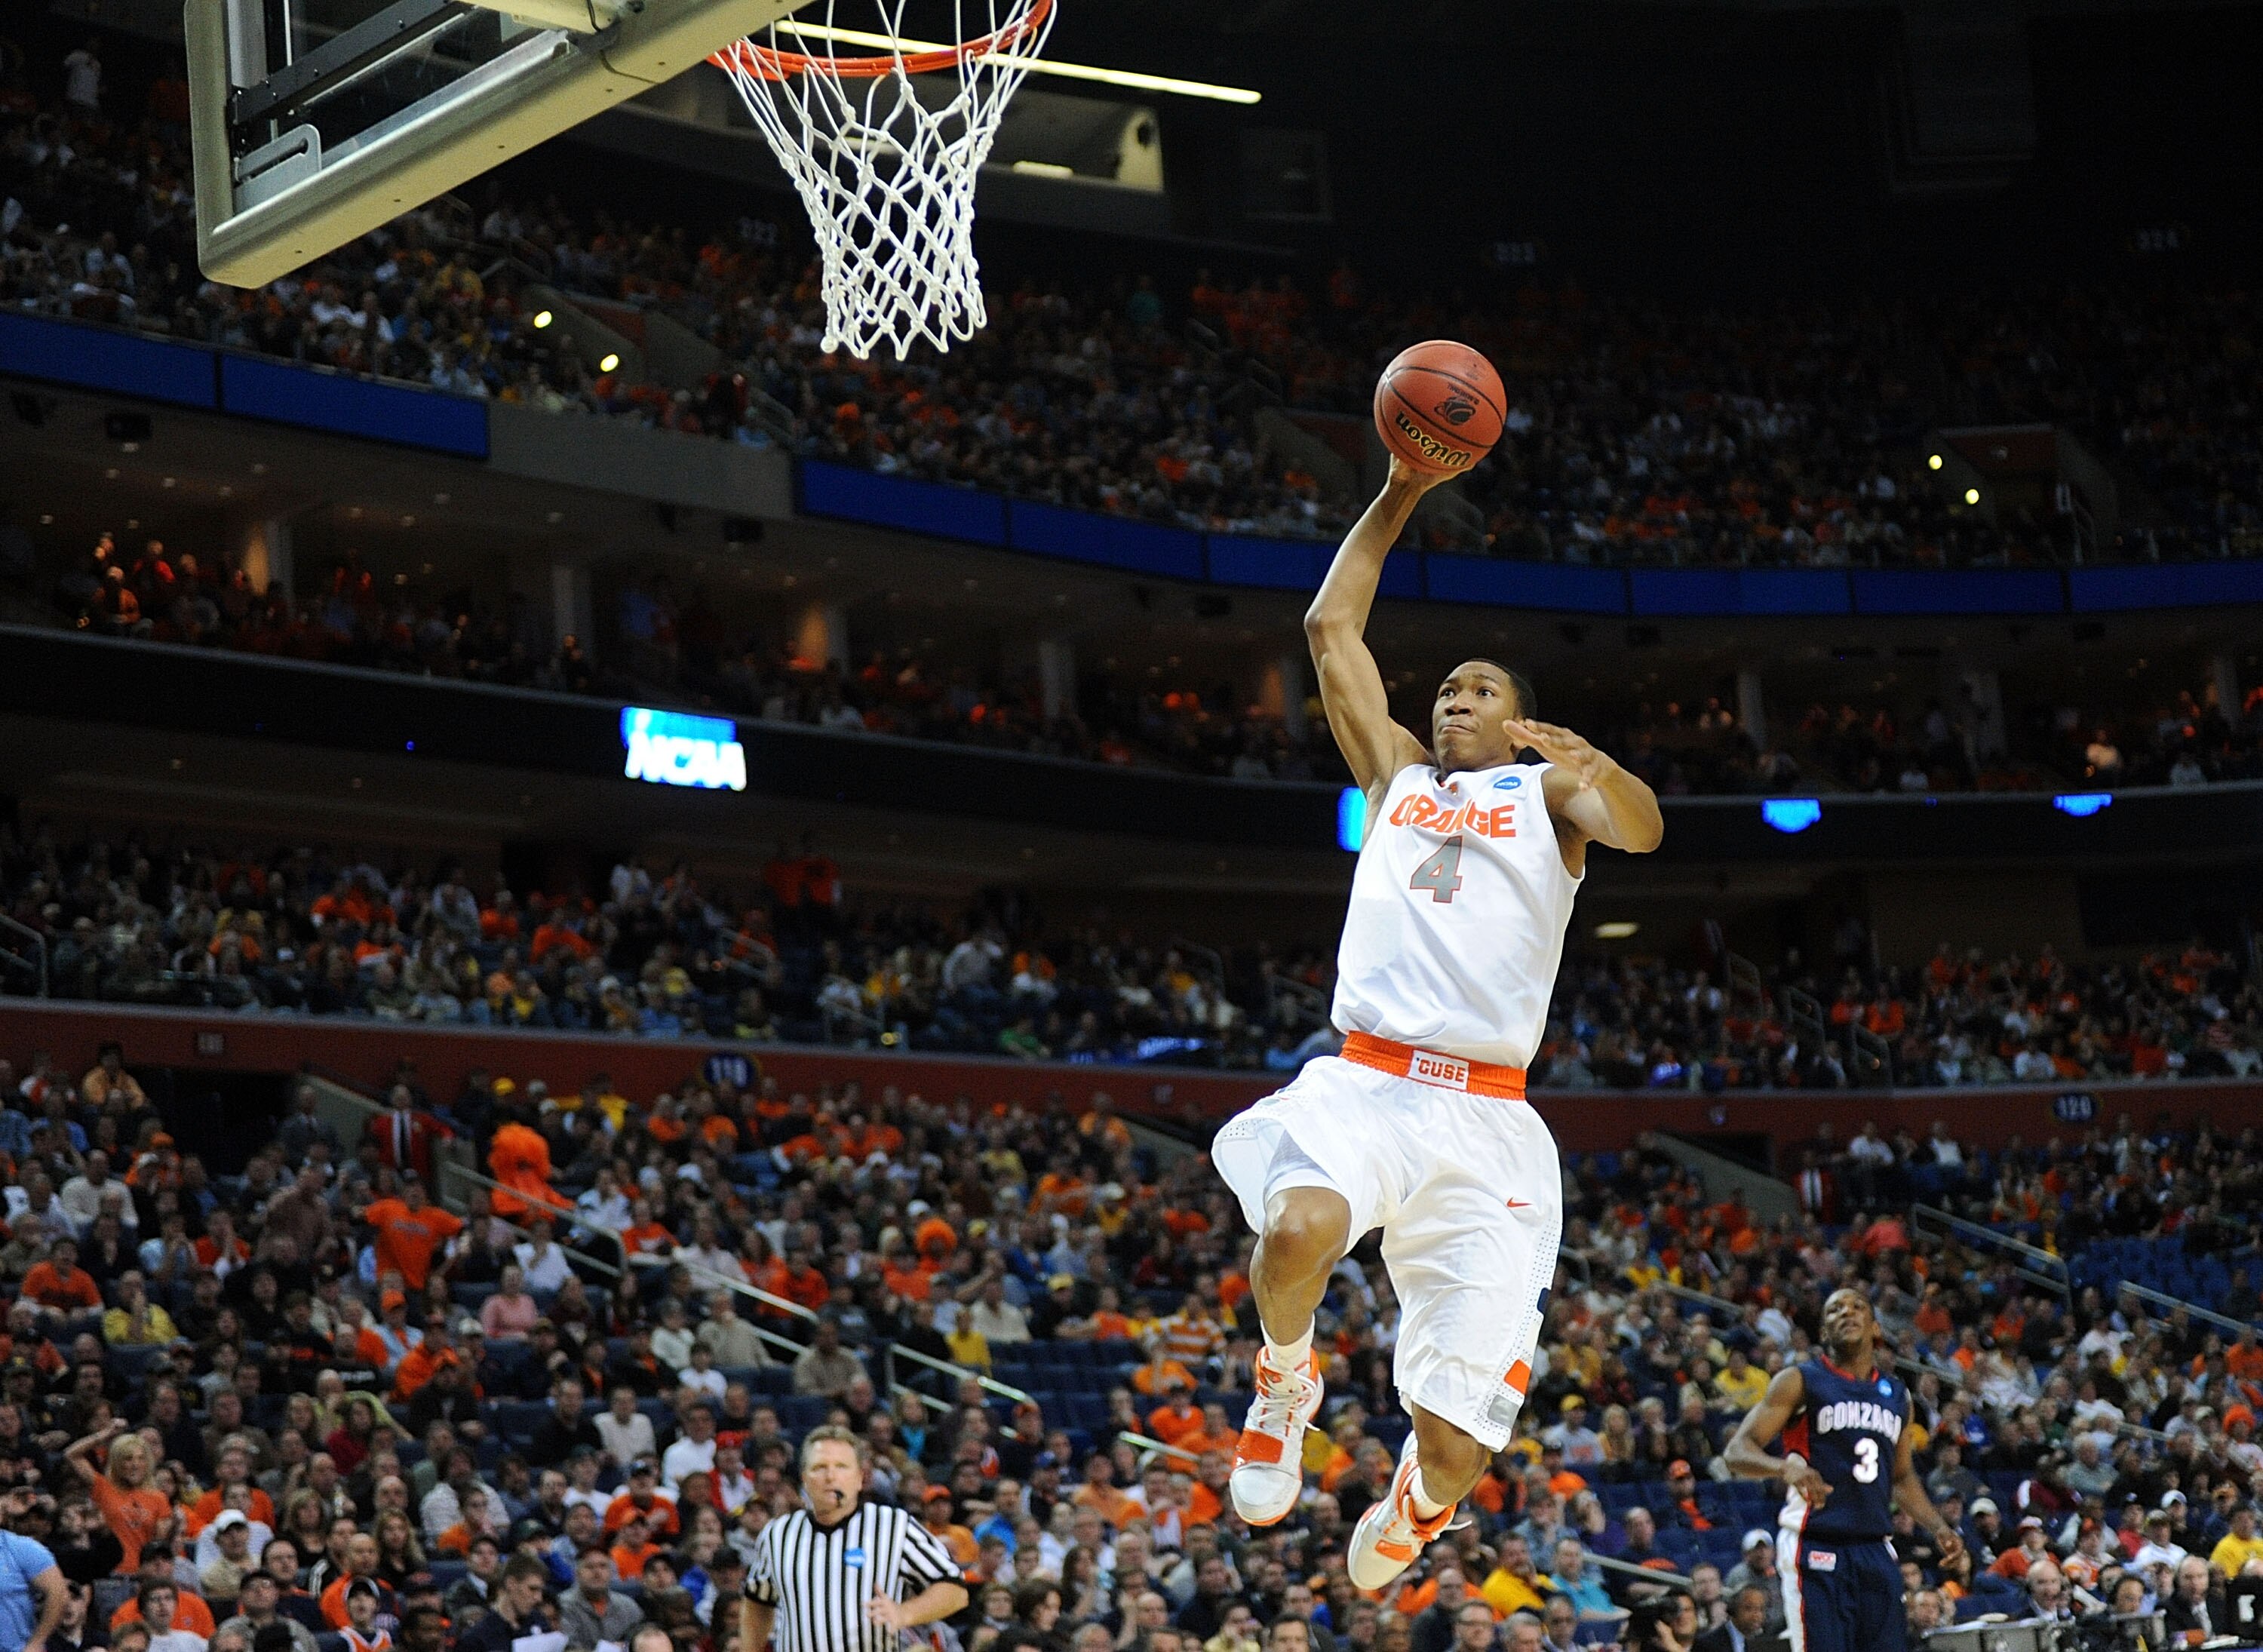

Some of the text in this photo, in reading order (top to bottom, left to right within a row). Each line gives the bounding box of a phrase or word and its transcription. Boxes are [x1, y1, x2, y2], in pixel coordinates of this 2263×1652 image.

[1396, 411, 1472, 466] Wilson
[625, 732, 748, 791] NCAA
[1389, 794, 1516, 839] ORANGE
[1409, 835, 1463, 904] 4
[1852, 1436, 1879, 1485] 3
